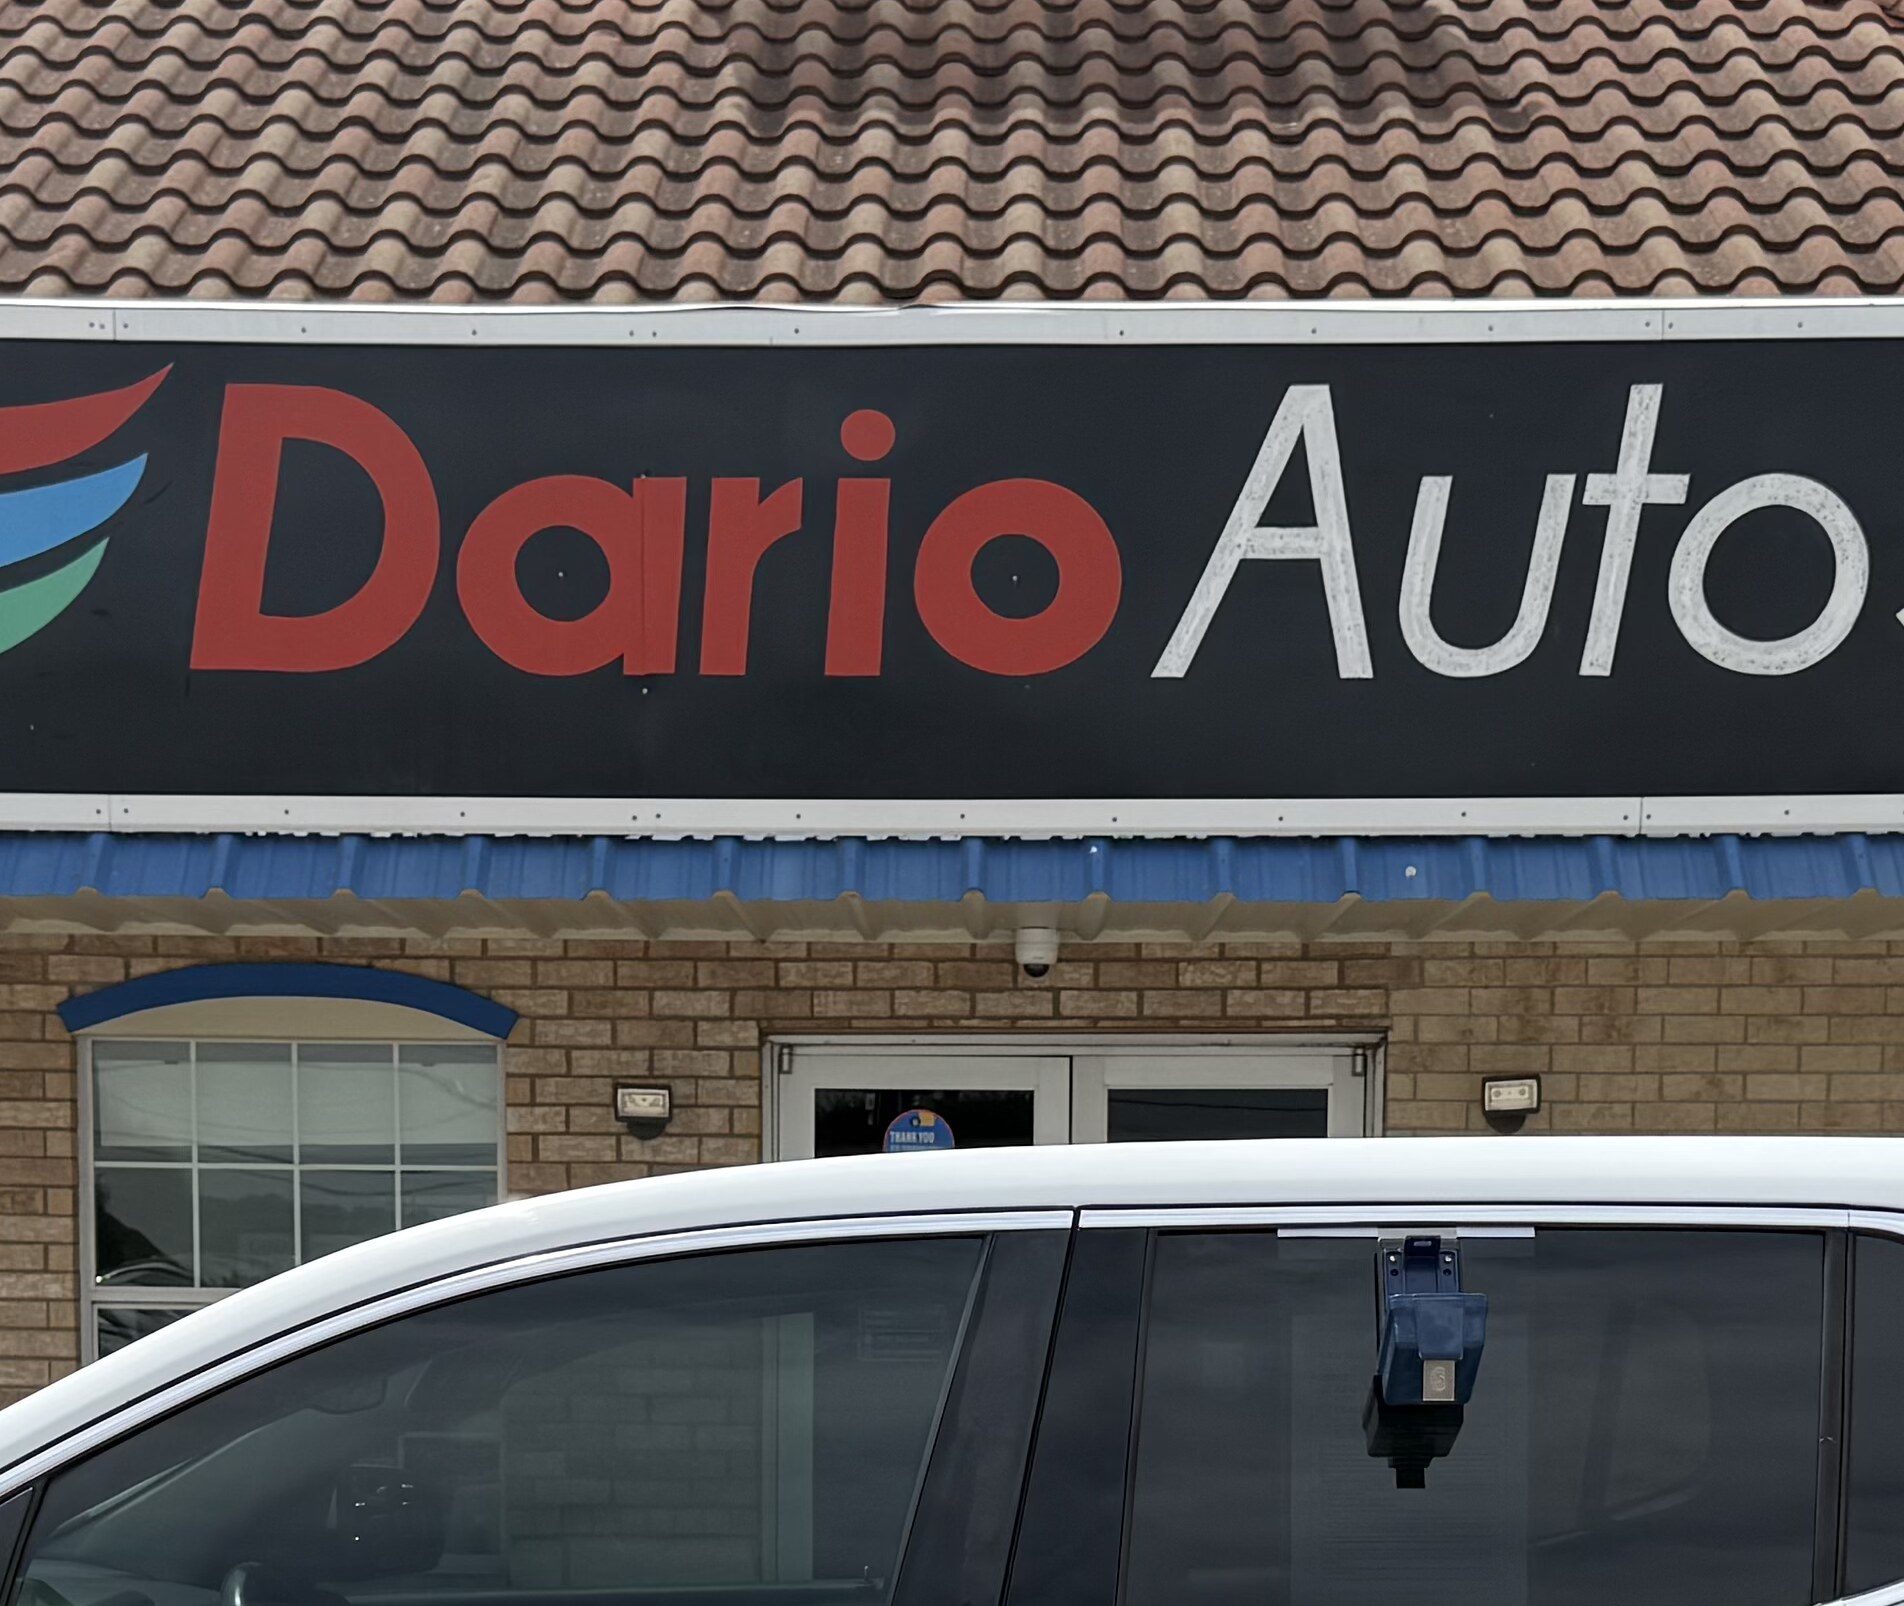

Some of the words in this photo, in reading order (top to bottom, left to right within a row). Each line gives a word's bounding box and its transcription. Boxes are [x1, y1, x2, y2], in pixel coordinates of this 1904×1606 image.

[190, 383, 1122, 676] Dario
[1151, 383, 1870, 678] Auto
[919, 1131, 935, 1143] YOU
